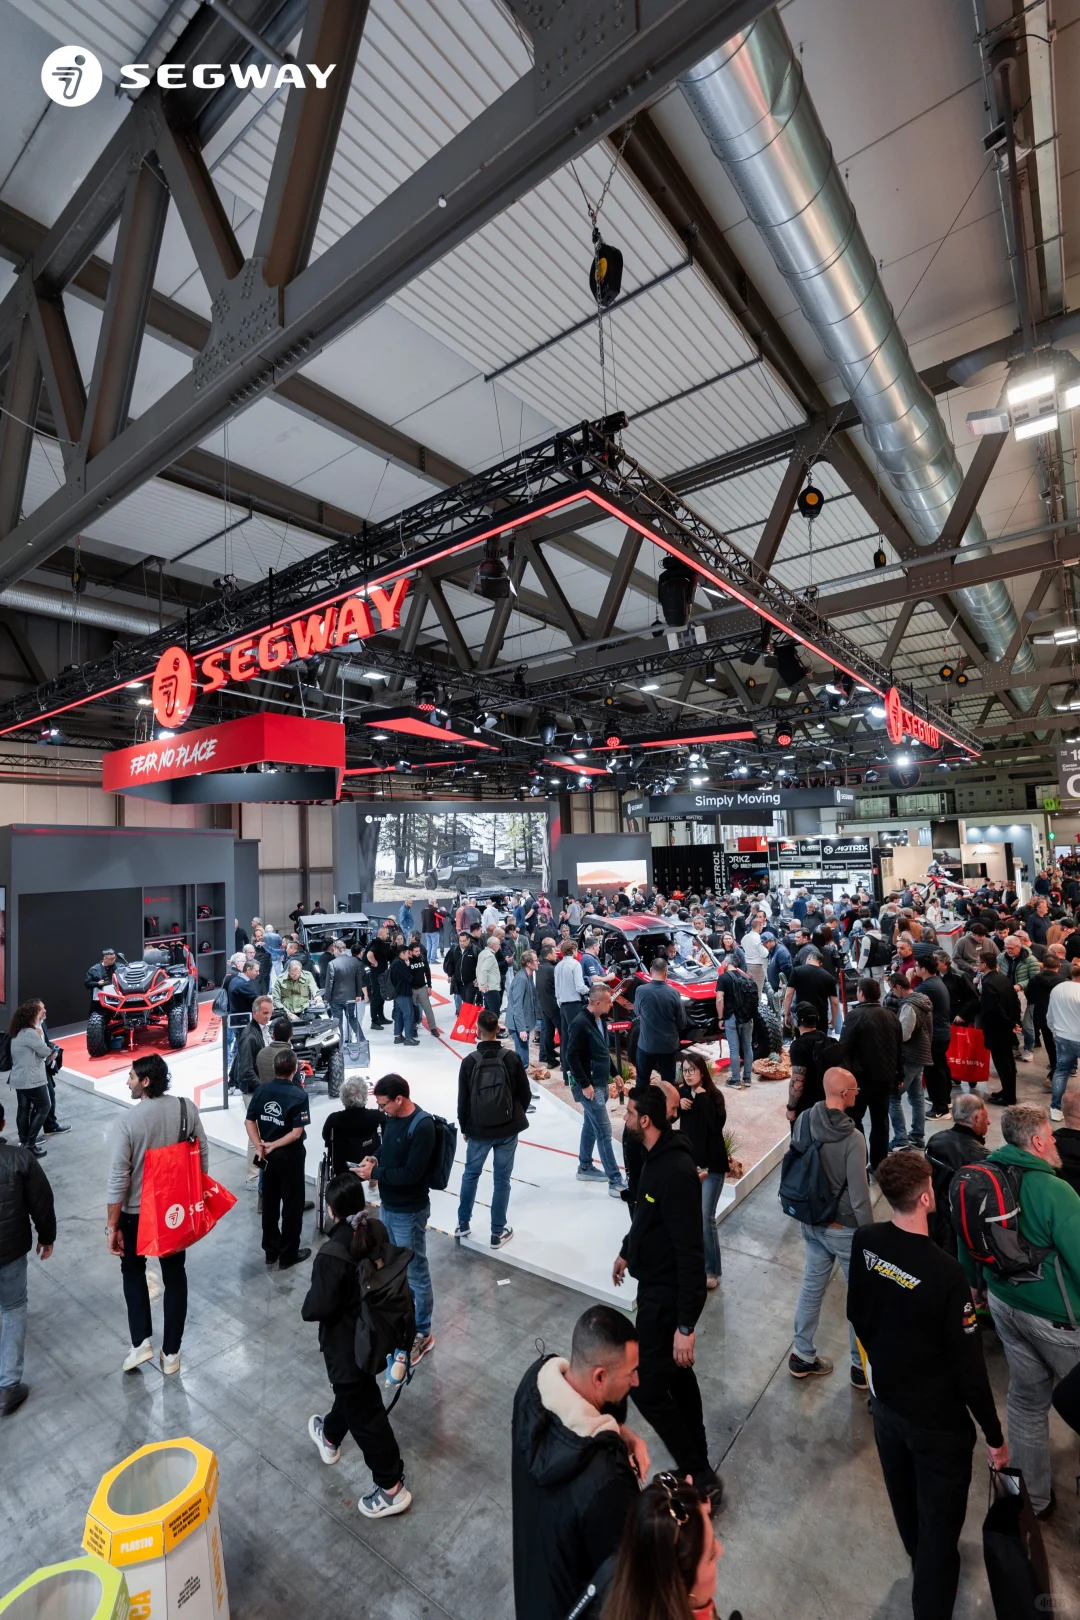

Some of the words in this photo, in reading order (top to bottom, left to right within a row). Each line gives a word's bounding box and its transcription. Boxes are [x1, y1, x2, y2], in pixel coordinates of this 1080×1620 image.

[201, 577, 411, 693] SEGWAY
[902, 711, 940, 750] SEGWAY
[130, 750, 158, 777] FEAR
[157, 746, 176, 773] NO
[175, 738, 218, 769] PLACE
[695, 793, 733, 808] Simply
[737, 792, 781, 805] Moving
[835, 844, 868, 853] MOTRIX
[410, 962, 425, 970] BOSS
[873, 1265, 916, 1290] RACING
[876, 1258, 922, 1287] TRIUMPH
[120, 1535, 154, 1554] PLASTIC
